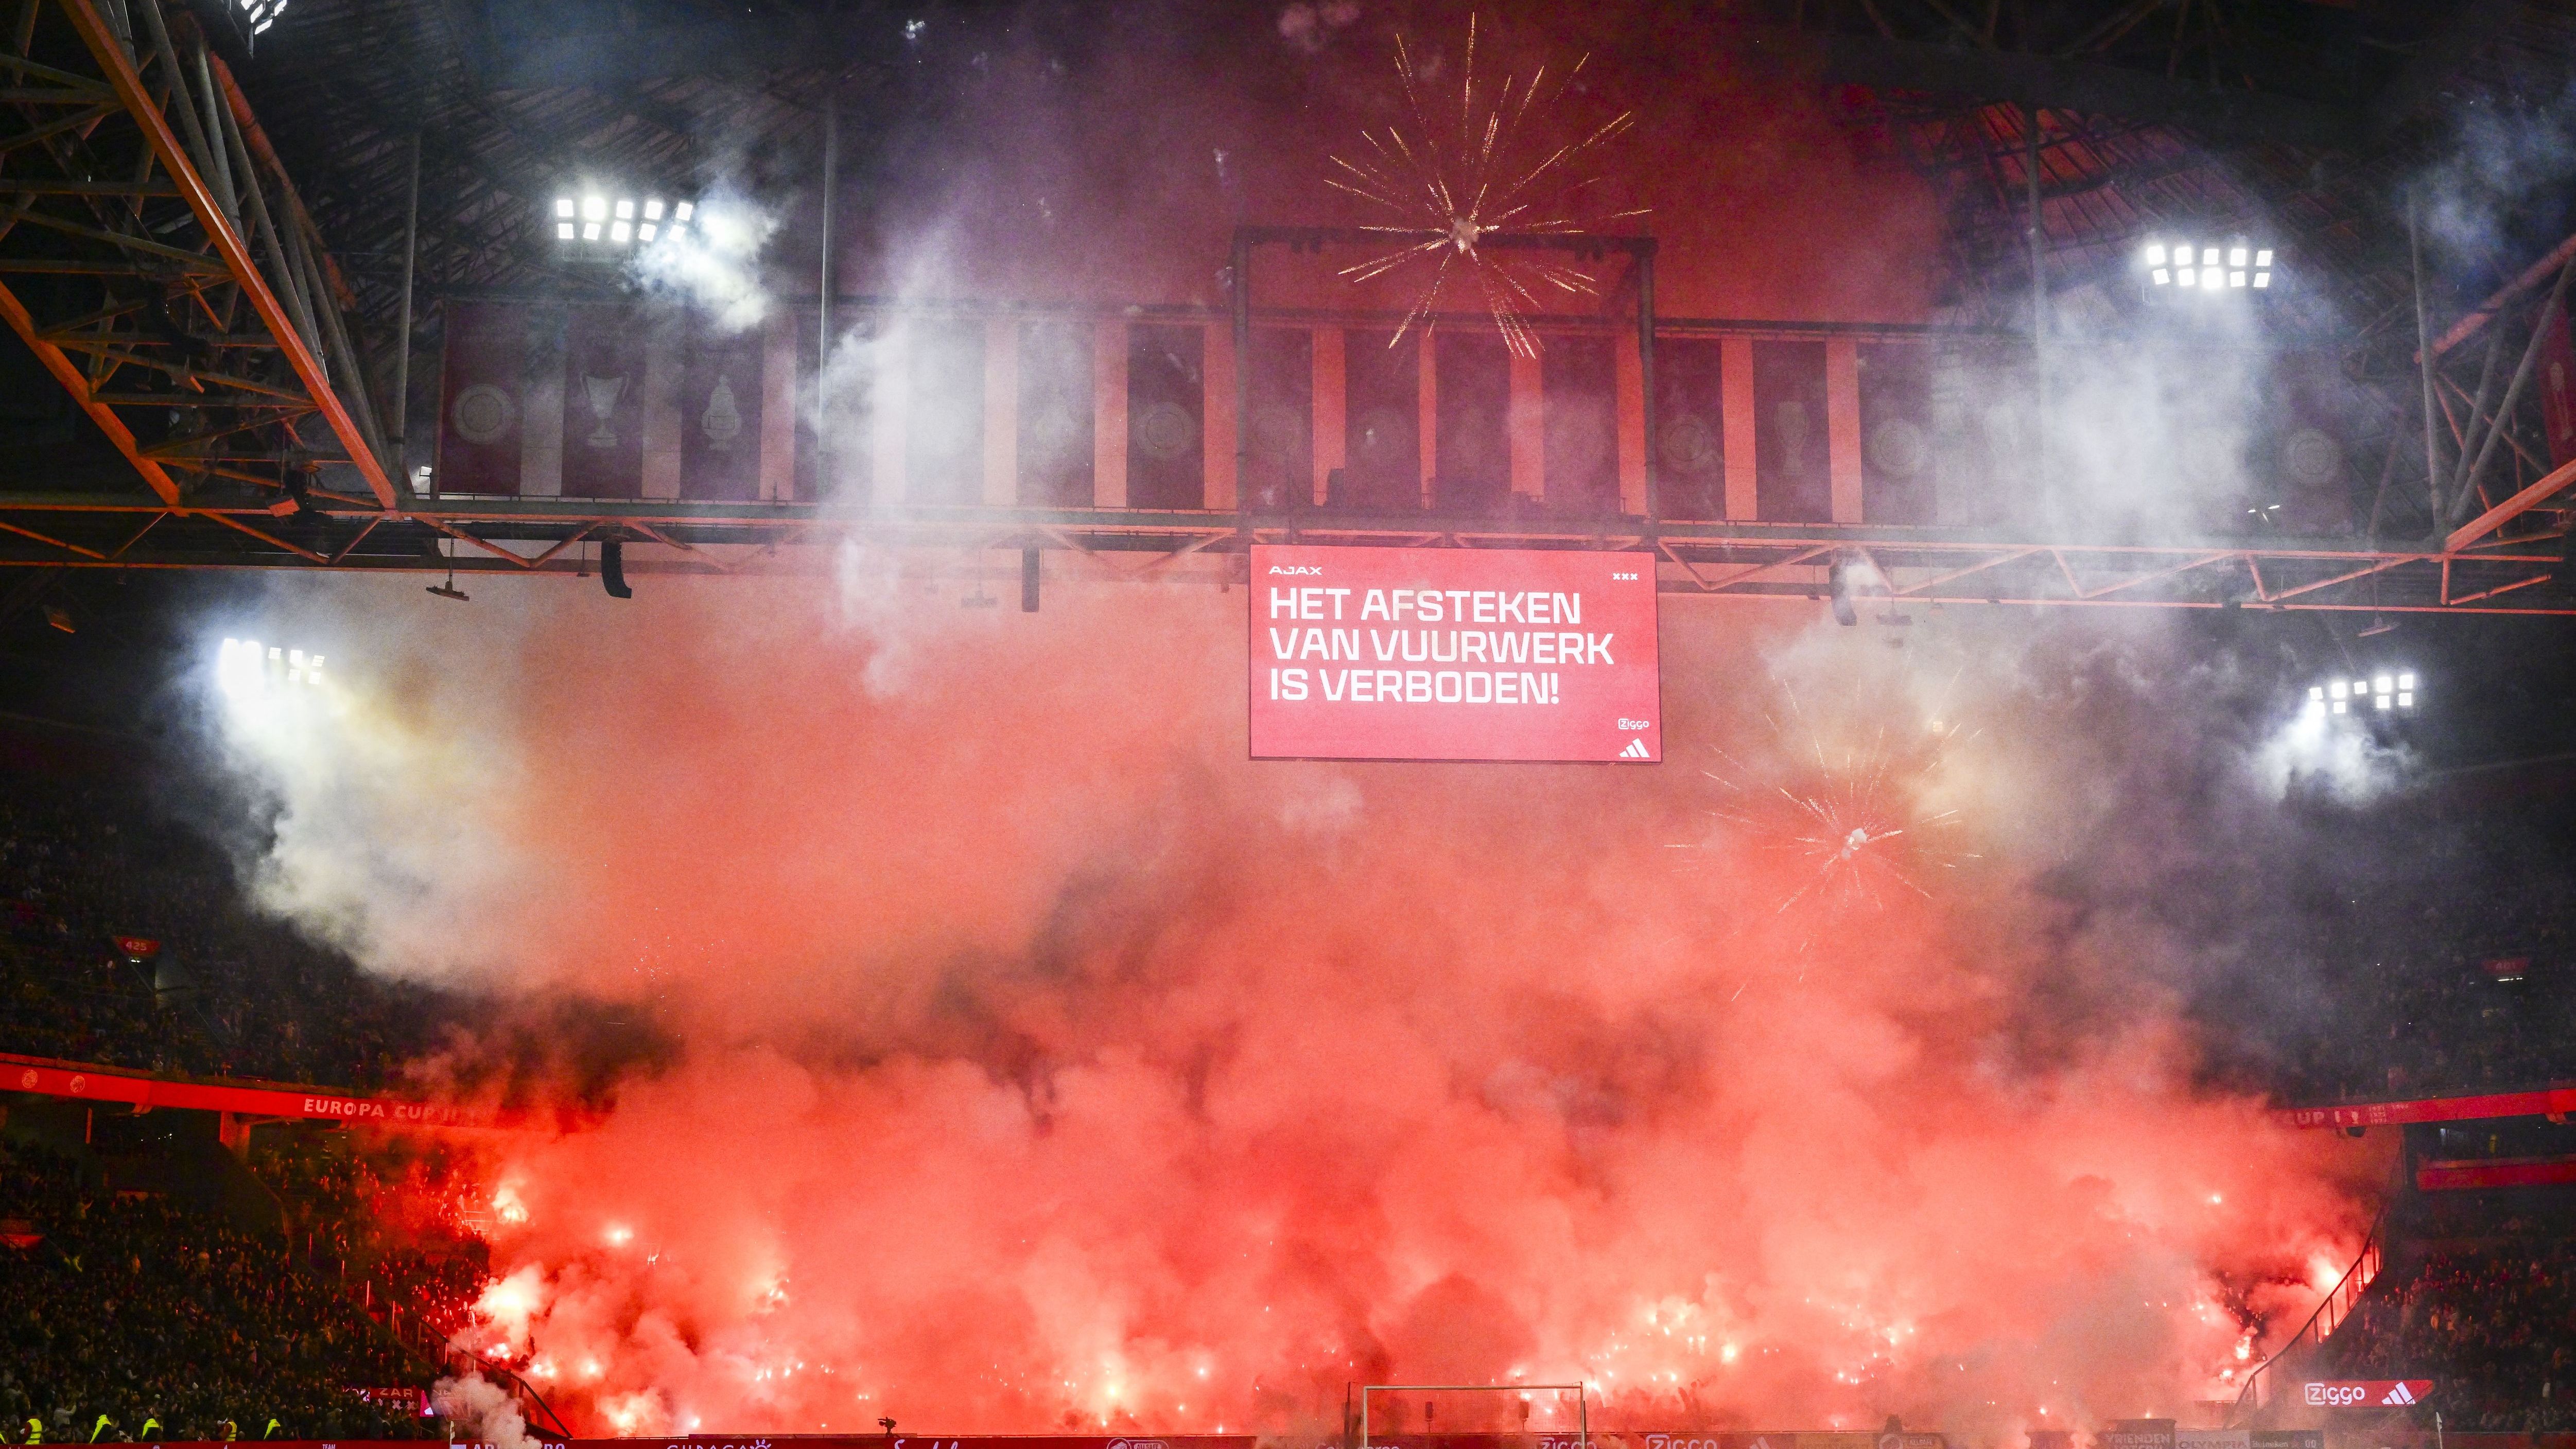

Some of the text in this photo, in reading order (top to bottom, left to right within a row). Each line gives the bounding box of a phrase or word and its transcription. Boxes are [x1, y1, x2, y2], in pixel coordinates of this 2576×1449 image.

[1268, 566, 1322, 575] AJAX
[1271, 587, 1580, 624] HET AFSTEKEN
[1269, 627, 1614, 665] VAN VUURWERK
[1272, 669, 1559, 704] IS VERBODEN!
[126, 940, 147, 951] 425
[304, 1097, 385, 1117] EUROPA
[394, 1105, 436, 1120] CUP
